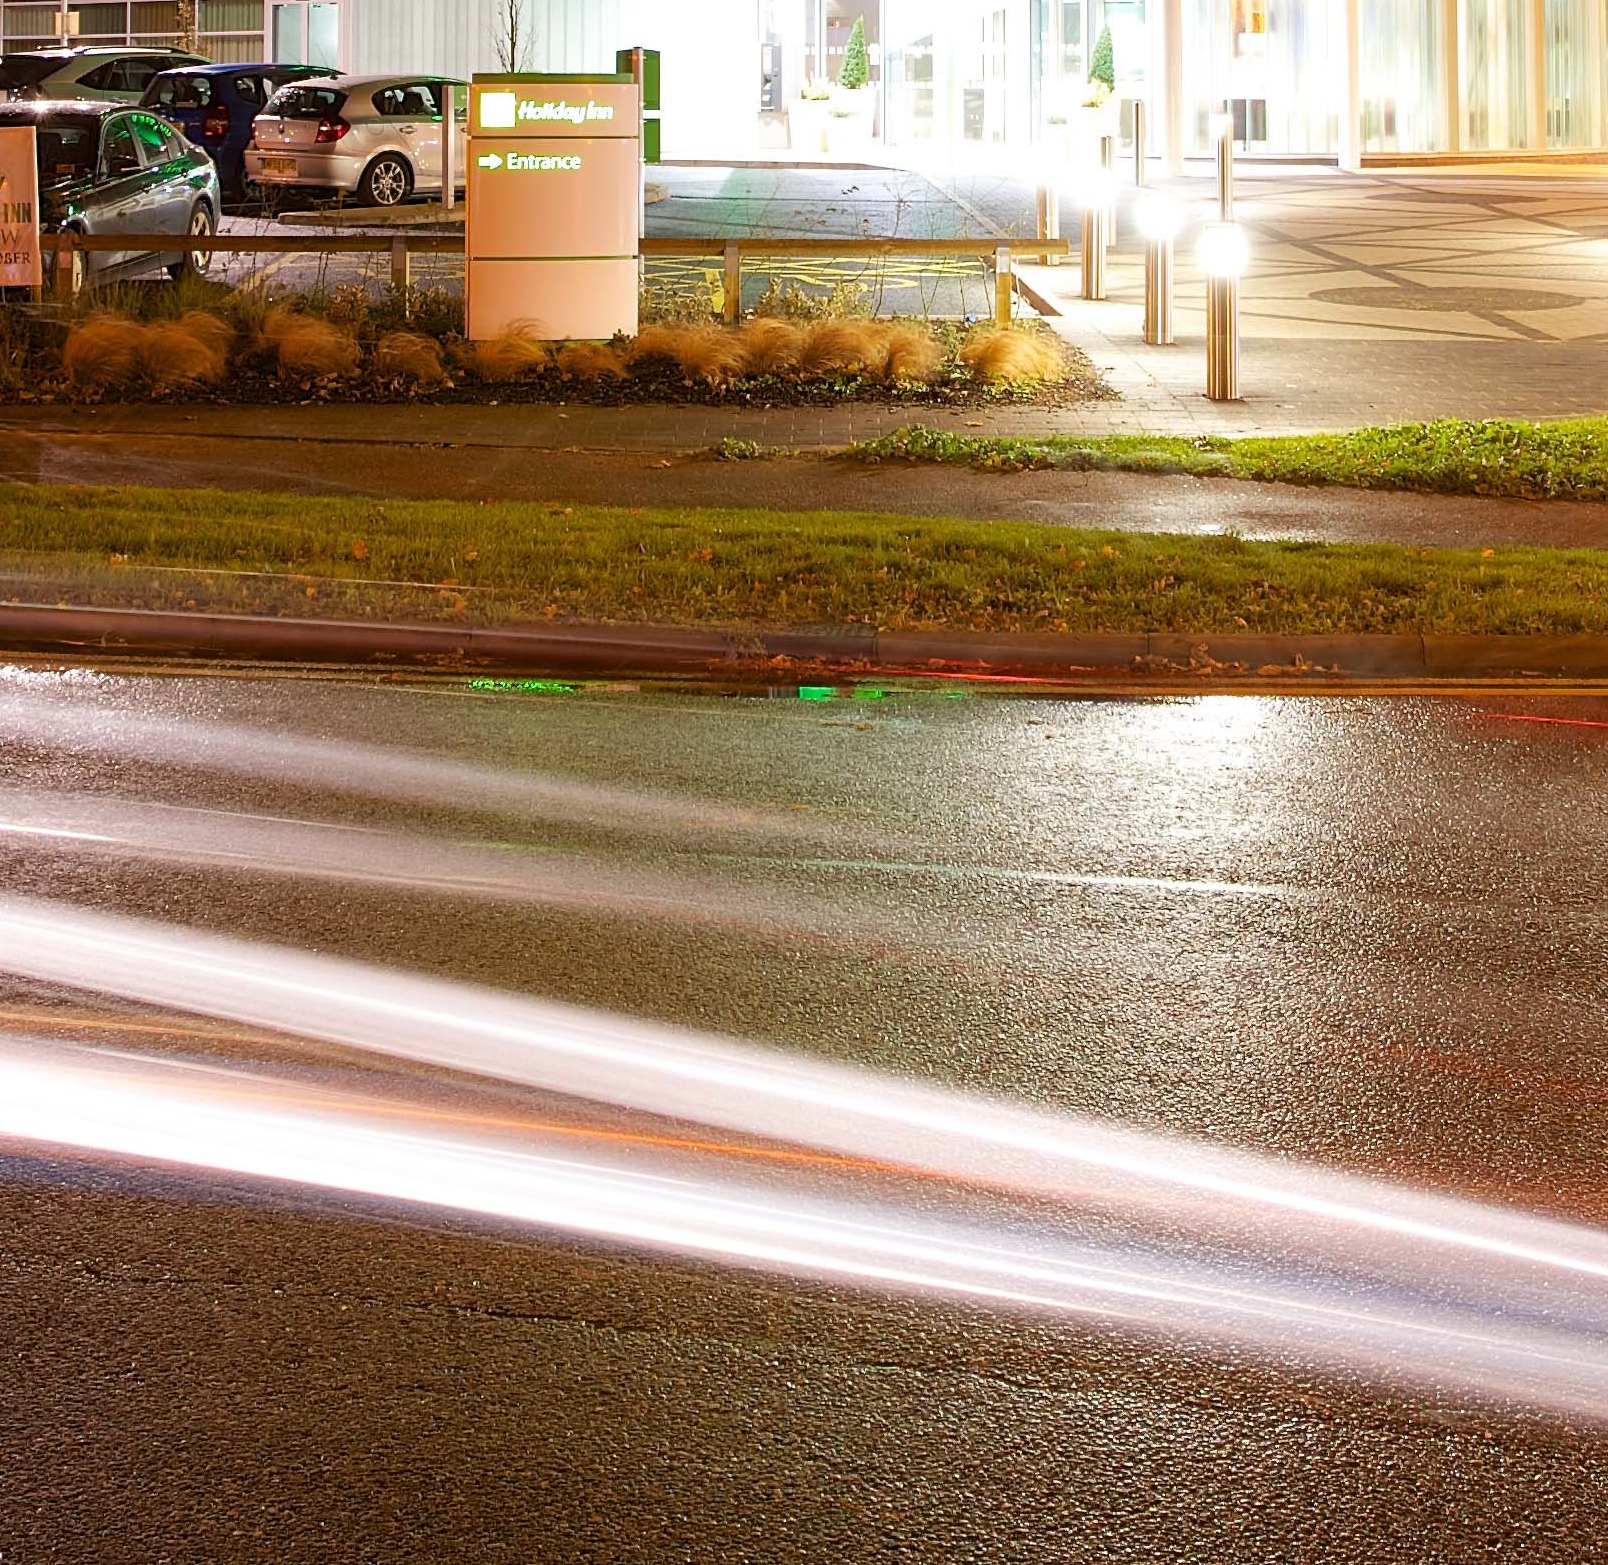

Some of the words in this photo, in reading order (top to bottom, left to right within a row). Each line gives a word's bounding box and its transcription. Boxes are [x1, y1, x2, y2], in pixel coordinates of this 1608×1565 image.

[518, 100, 587, 124] Holiday
[586, 100, 614, 120] Inn
[507, 152, 581, 170] Entrance
[3, 203, 32, 223] INN
